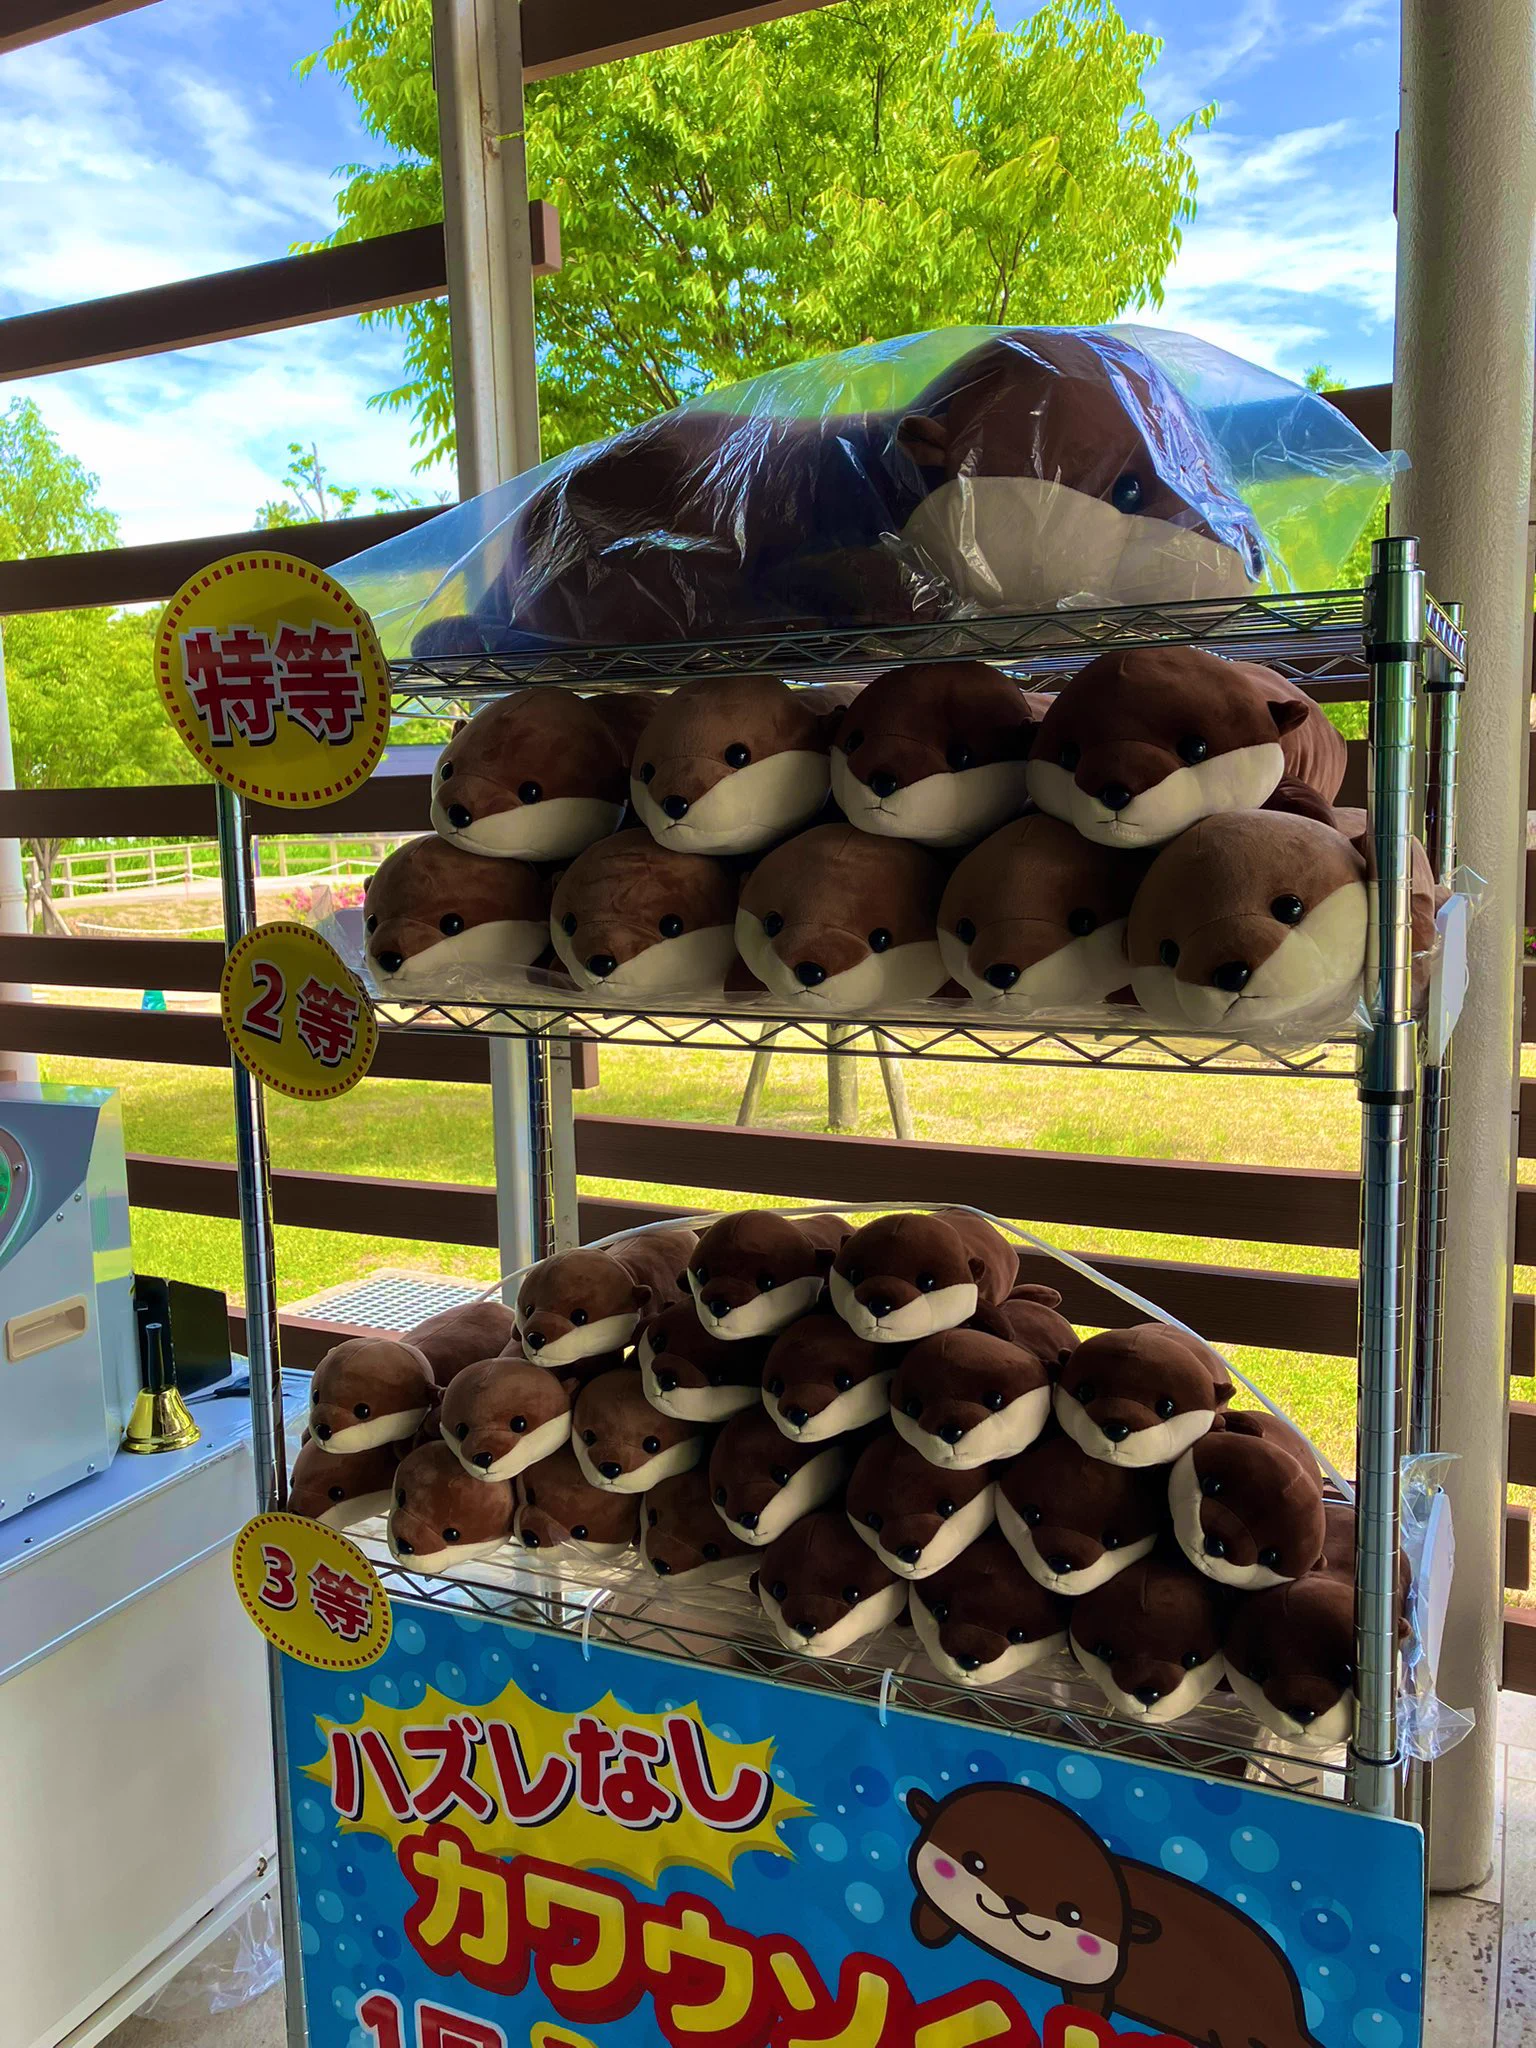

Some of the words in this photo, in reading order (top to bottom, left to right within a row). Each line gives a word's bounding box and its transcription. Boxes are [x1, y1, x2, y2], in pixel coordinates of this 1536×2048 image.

[178, 618, 365, 746] 特等
[242, 959, 359, 1067] 2等
[258, 1543, 373, 1642] 3等
[329, 1712, 770, 1830] ハズレなし
